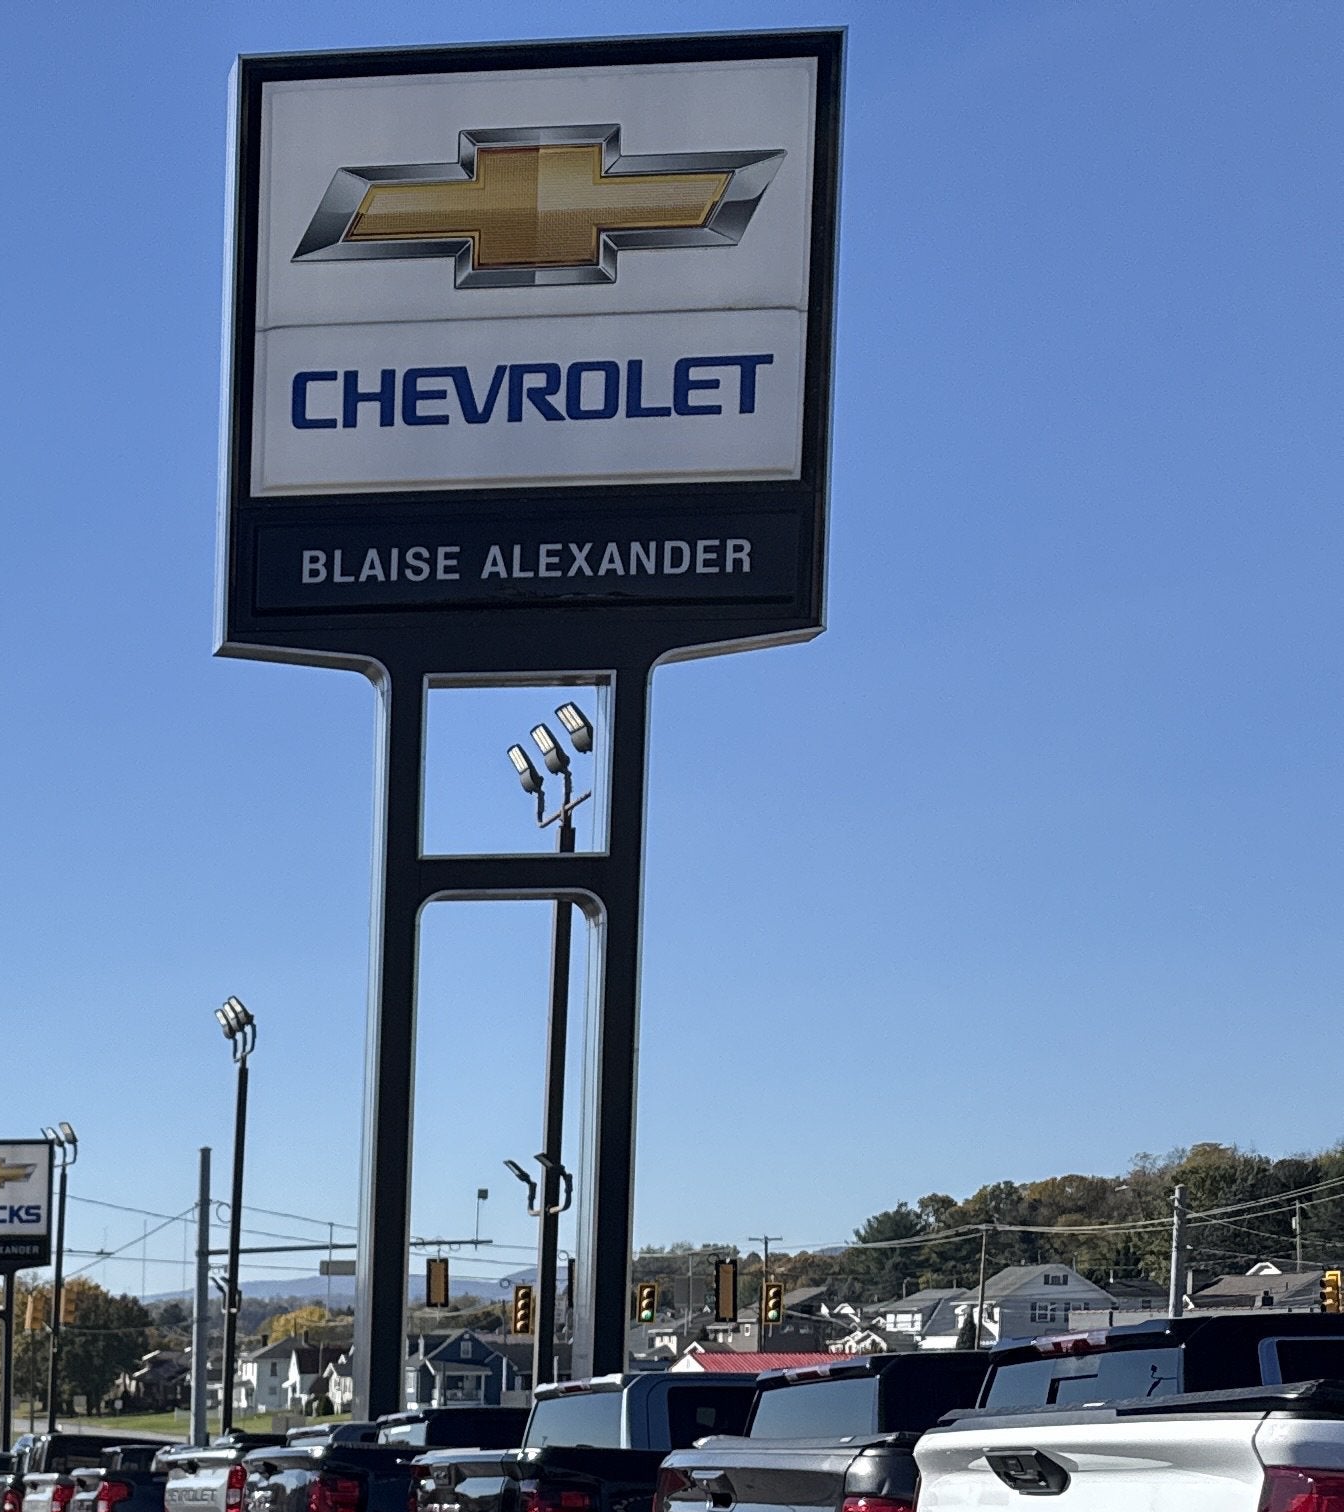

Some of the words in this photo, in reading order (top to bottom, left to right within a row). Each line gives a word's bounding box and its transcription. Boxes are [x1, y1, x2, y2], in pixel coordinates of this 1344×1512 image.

[292, 353, 774, 430] CHEVROLET
[302, 546, 461, 584] BLAISE
[480, 538, 753, 580] ALEXANDER
